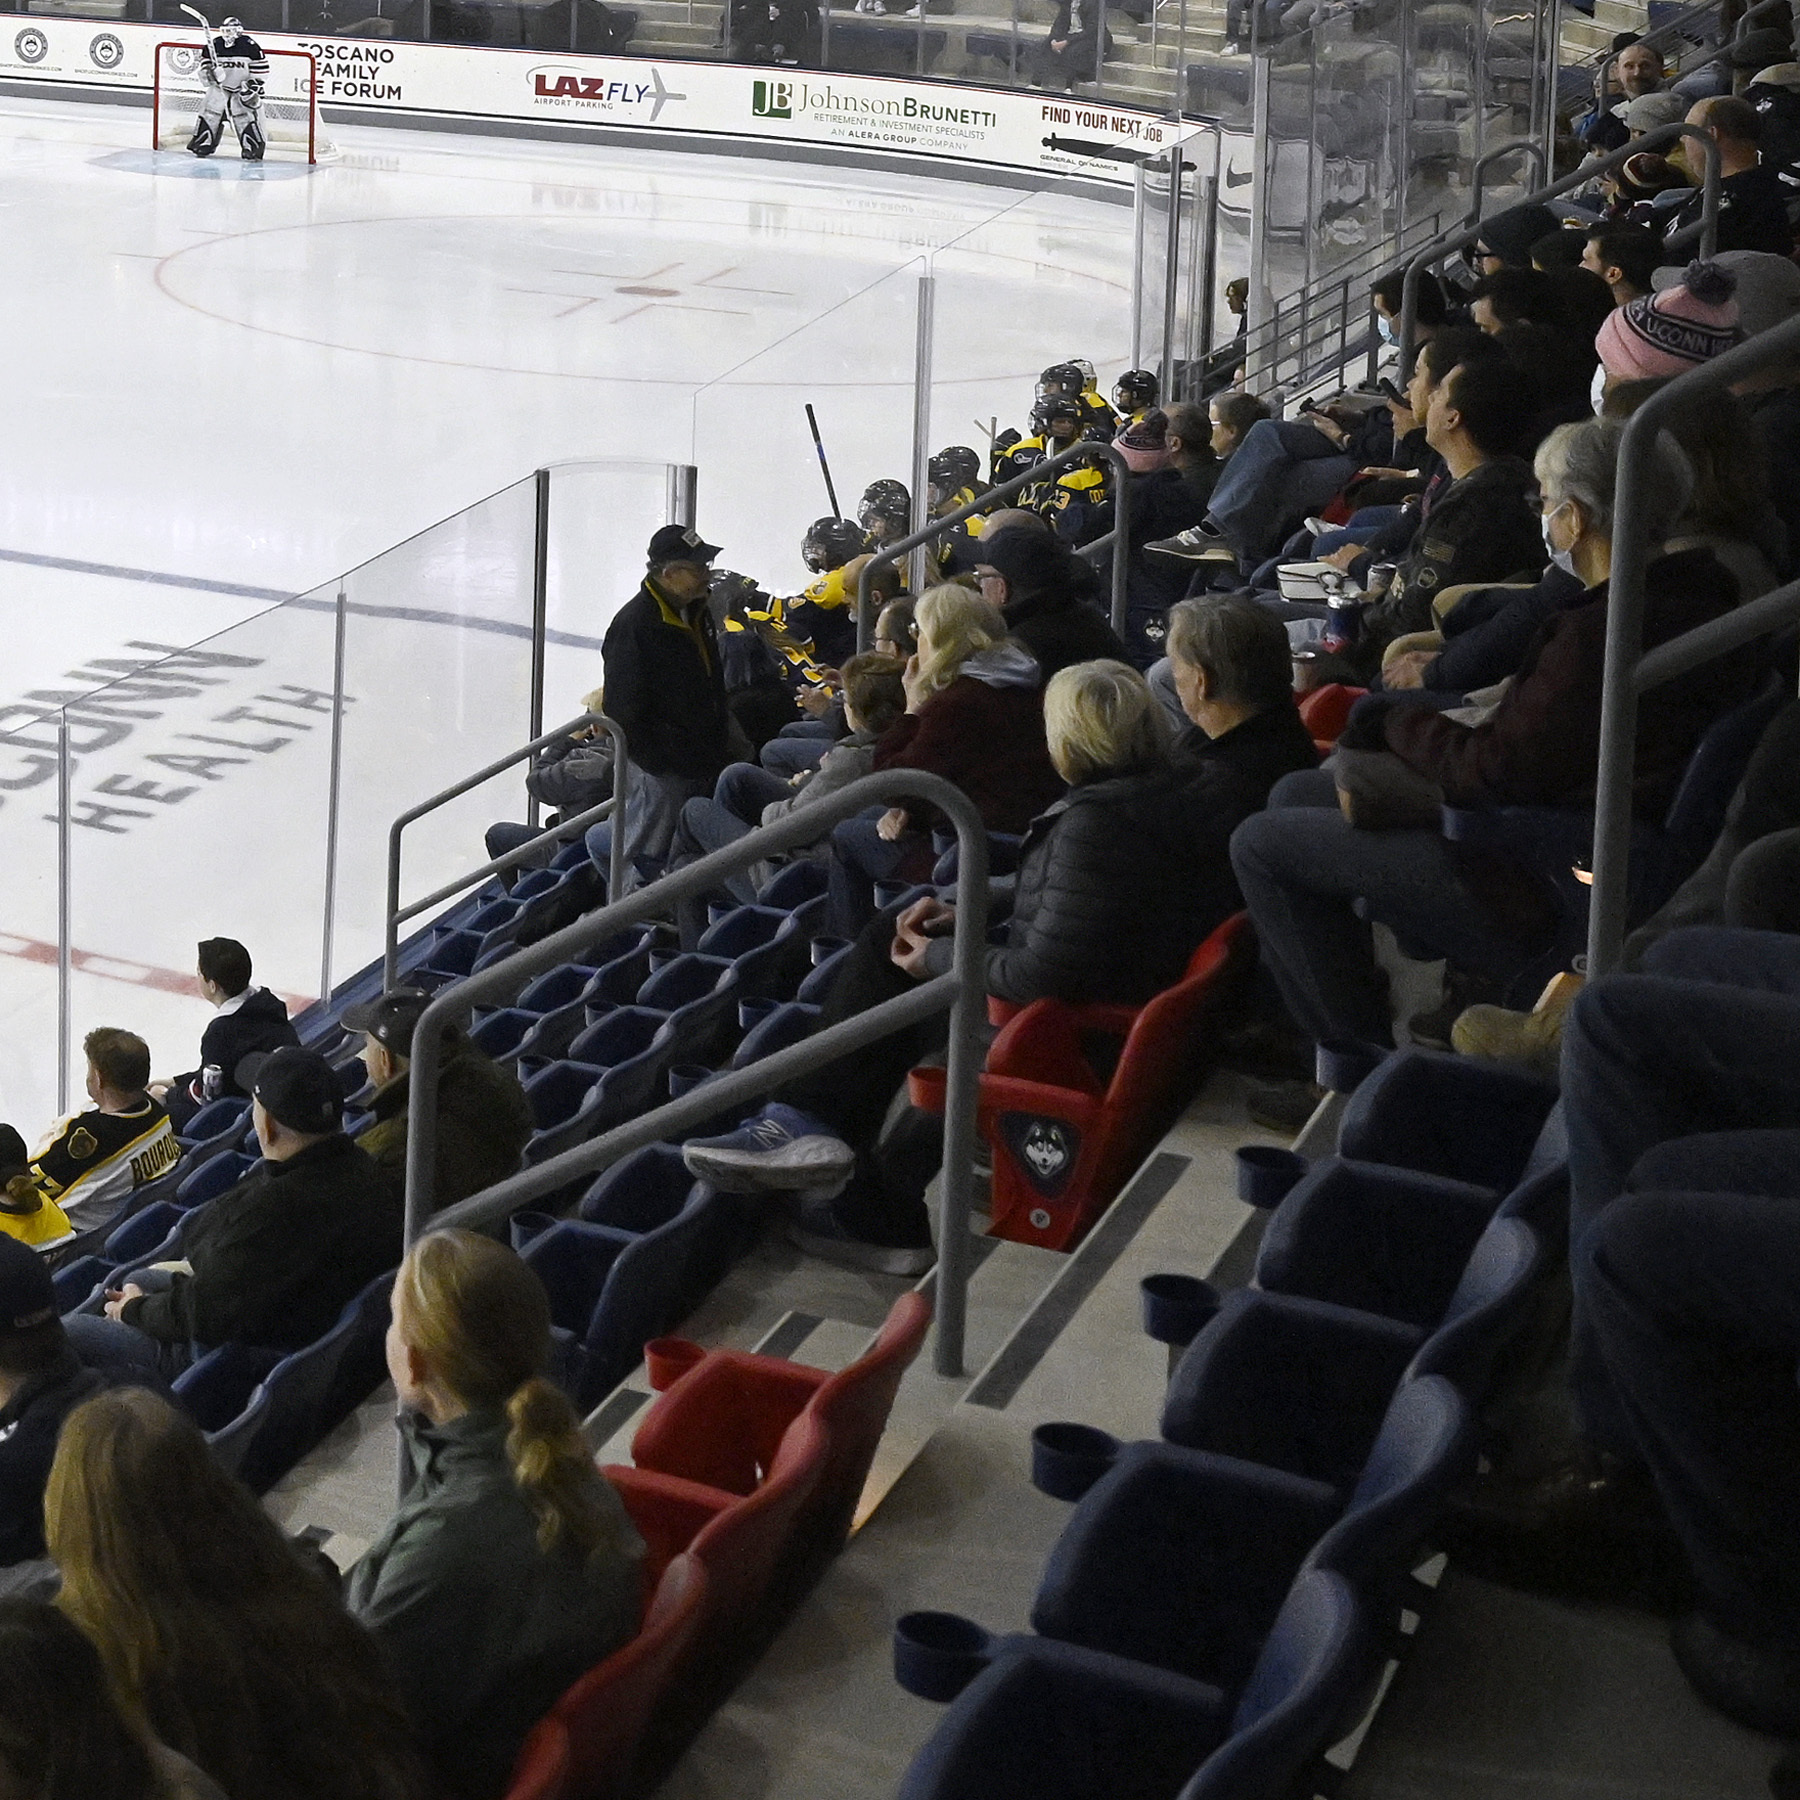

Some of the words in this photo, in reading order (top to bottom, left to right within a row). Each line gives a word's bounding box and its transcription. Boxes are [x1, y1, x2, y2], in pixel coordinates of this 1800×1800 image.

[332, 81, 402, 101] FORUM
[535, 74, 605, 100] LAZ
[607, 82, 650, 104] FLY
[534, 98, 572, 107] AIRPORT
[575, 100, 614, 111] PARKING
[814, 112, 868, 126] RETIREMENT
[879, 118, 933, 134] INVESTMENT
[935, 125, 986, 141] SPECIALISTS
[1042, 105, 1071, 124] FIND
[1075, 110, 1109, 129] YOUR
[1111, 116, 1142, 135] NEXT
[1143, 126, 1163, 143] JOB
[848, 129, 881, 140] ALERA
[883, 133, 918, 144] GROUP
[920, 136, 969, 151] COMPANY
[1039, 154, 1077, 166] GENERAL
[42, 684, 356, 834] HEALTH
